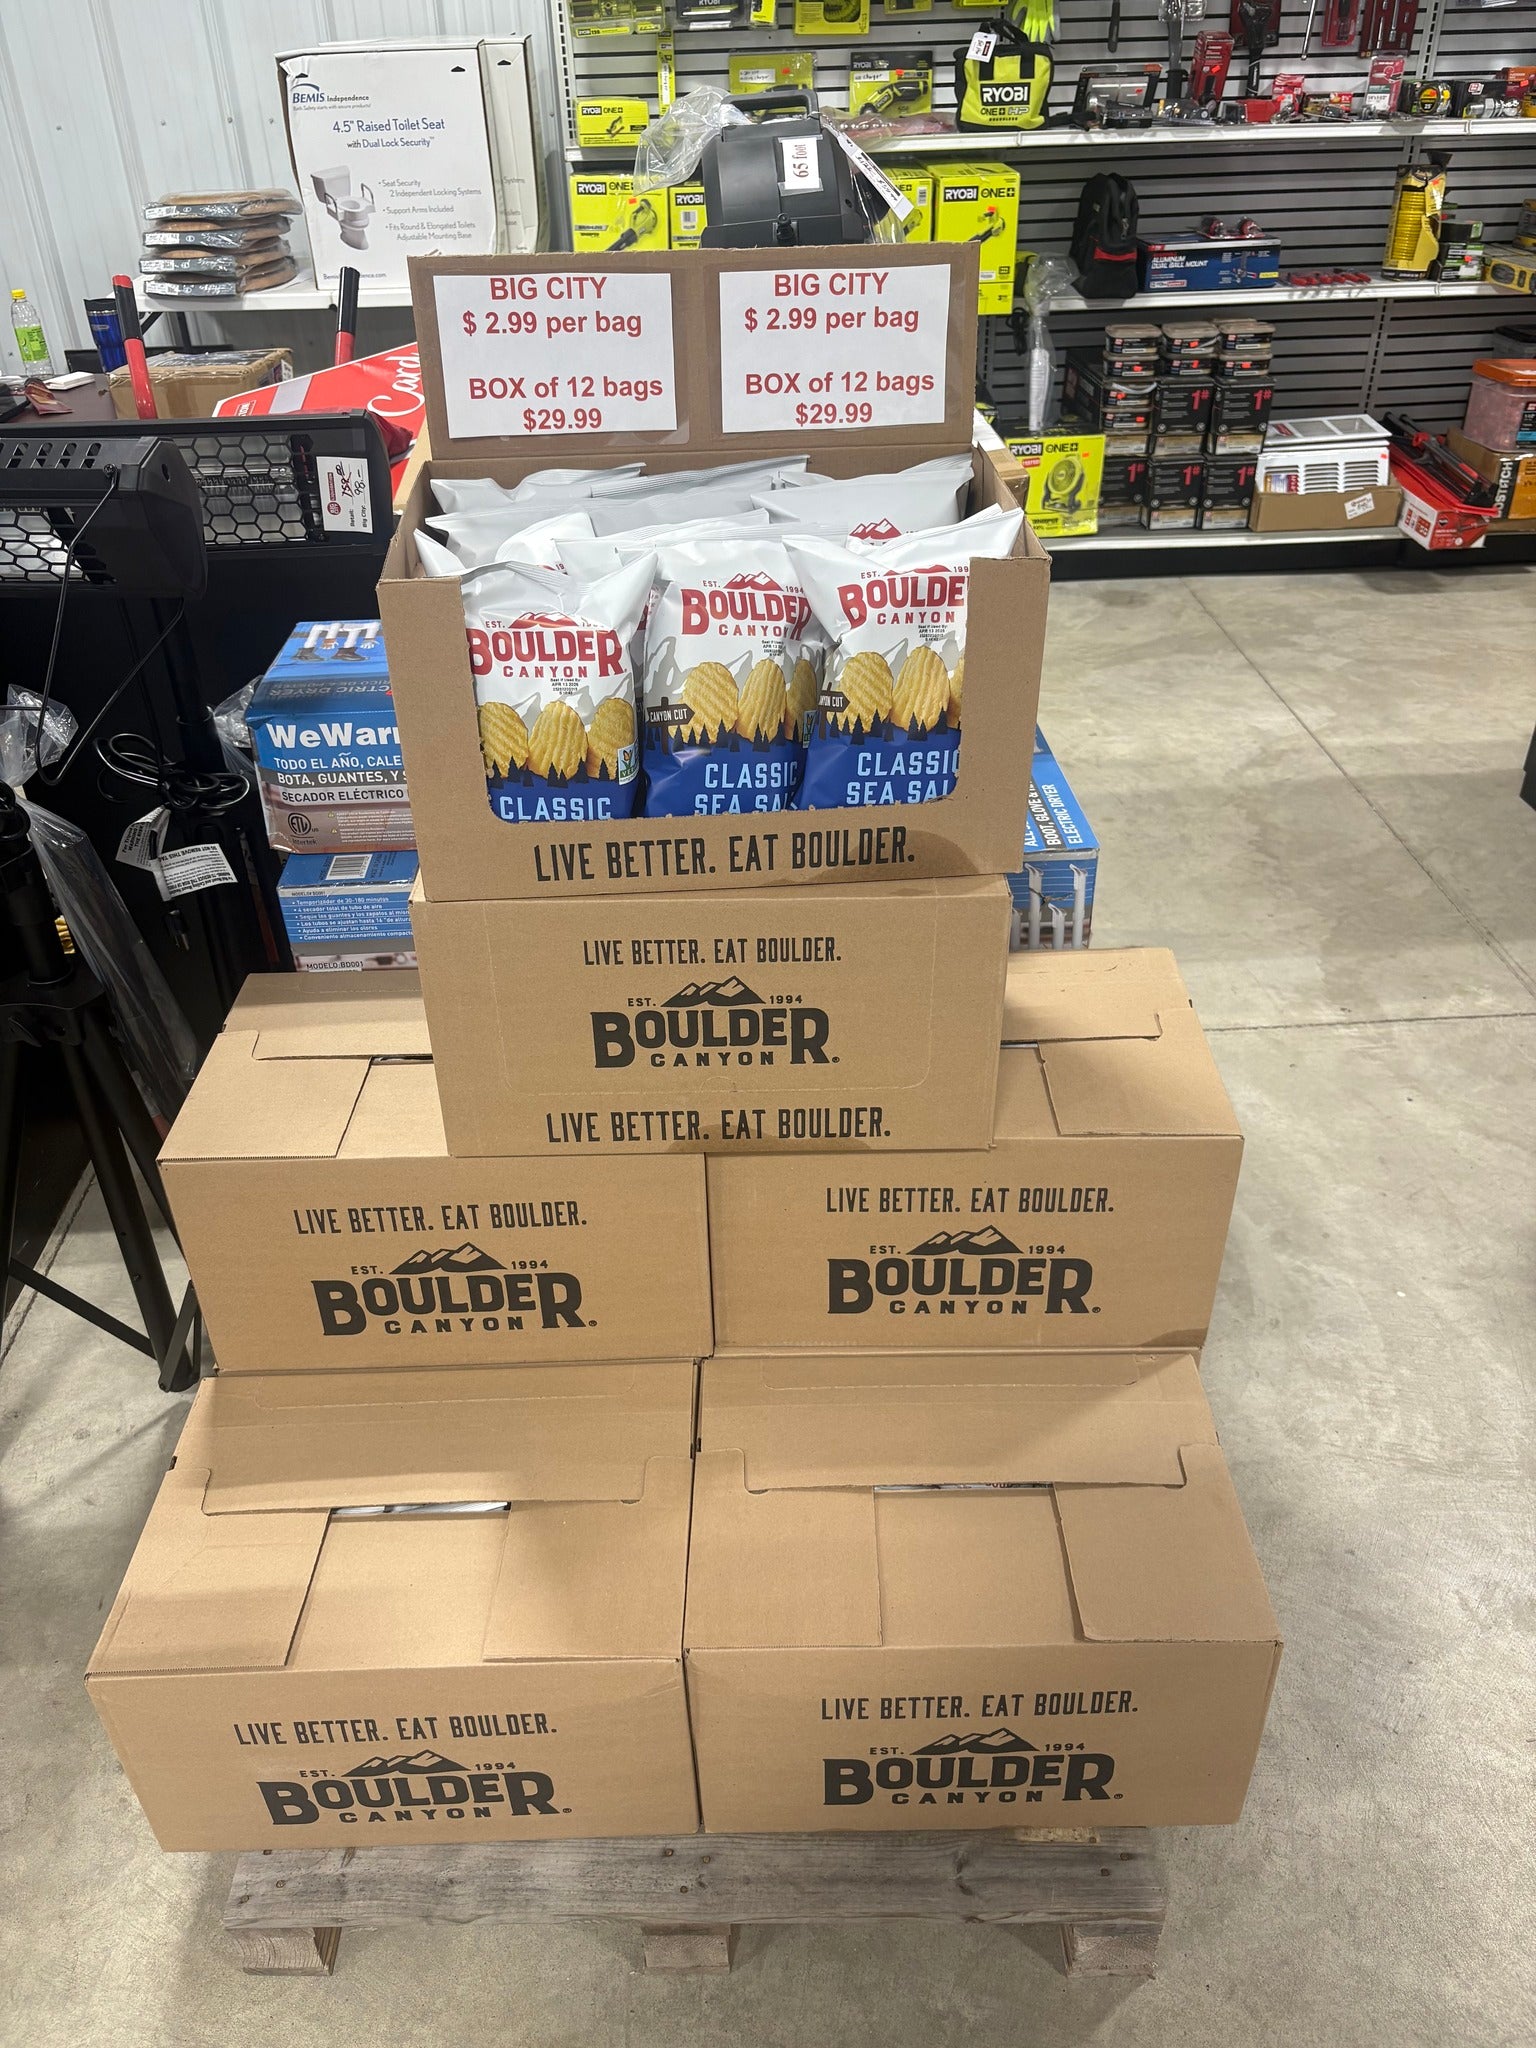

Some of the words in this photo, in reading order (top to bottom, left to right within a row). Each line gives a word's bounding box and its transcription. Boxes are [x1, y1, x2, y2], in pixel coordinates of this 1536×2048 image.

[292, 92, 325, 104] BEMIS
[326, 94, 370, 103] Independence
[982, 87, 1029, 103] RYOBI
[1007, 107, 1030, 116] HP
[333, 120, 355, 133] 4.5"
[357, 119, 391, 132] Raised
[392, 118, 421, 131] Toilet
[422, 117, 445, 130] Seat
[347, 139, 362, 149] with
[362, 138, 380, 148] Dual
[381, 138, 399, 147] Lock
[792, 162, 809, 178] 65
[382, 179, 396, 188] Seat
[396, 178, 421, 188] Security
[578, 183, 606, 195] RYOBI
[395, 188, 432, 198] Independent
[432, 188, 457, 197] Locking
[457, 187, 482, 197] Systems
[676, 194, 704, 206] RYOBI
[945, 188, 977, 200] RYOBI
[386, 207, 410, 216] Support
[411, 206, 428, 214] Arms
[428, 205, 454, 213] Included
[389, 223, 399, 231] Fits
[400, 222, 420, 230] Round
[426, 222, 457, 231] Elongated
[457, 221, 476, 229] Toilets
[396, 232, 427, 241] Adjustable
[427, 231, 457, 240] Mounting
[457, 231, 472, 239] Base
[1185, 260, 1208, 268] MOUNT
[490, 277, 538, 300] BIG
[546, 276, 607, 300] CITY
[774, 273, 820, 297] BIG
[829, 272, 889, 296] CITY
[462, 310, 477, 337] $
[485, 311, 537, 334] 2.99
[546, 315, 587, 338] per
[596, 310, 642, 338] bag
[744, 307, 758, 333] $
[766, 307, 817, 330] 2.99
[826, 311, 866, 334] per
[874, 306, 919, 333] bag
[367, 352, 423, 417] Card
[469, 377, 527, 400] BOX
[534, 376, 559, 398] of
[567, 376, 595, 397] 12
[603, 375, 663, 402] bags
[745, 372, 801, 395] BOX
[808, 372, 834, 393] of
[841, 371, 868, 392] 12
[876, 371, 935, 396] bags
[523, 407, 602, 433] $29.99
[795, 402, 873, 427] $29.99
[1010, 444, 1042, 456] RYOBI
[860, 571, 881, 580] EST.
[703, 580, 721, 588] EST.
[785, 585, 804, 594] 1994
[837, 576, 971, 630] BOULDE
[681, 588, 813, 642] BOULDER
[876, 611, 955, 625] CANYON
[485, 620, 505, 629] EST.
[466, 628, 623, 678] BOULDER
[503, 666, 588, 678] CANYON
[831, 696, 844, 708] CUT
[650, 710, 671, 722] CANYON
[674, 708, 688, 721] CUT
[273, 757, 307, 771] TODO
[311, 757, 328, 769] EL
[331, 751, 364, 769] AÑO,
[277, 772, 315, 786] BOTA,
[318, 771, 388, 784] GUANTES,
[390, 770, 398, 782] Y
[704, 761, 798, 789] CLASSIC
[282, 791, 335, 803] SECADOR
[338, 788, 404, 801] ELÉCTRICO
[846, 781, 895, 805] SEA
[1041, 783, 1062, 809] DRYER
[499, 796, 611, 821] CLASSIC
[694, 794, 742, 816] SEA
[1028, 800, 1050, 823] GLOVE
[1038, 821, 1062, 847] BOOT,
[1052, 807, 1084, 845] ELECTRIC
[533, 843, 595, 882] LIVE
[606, 837, 716, 879] BETTER.
[729, 834, 779, 873] EAT
[791, 826, 915, 869] BOULDER.
[583, 939, 624, 966] LIVE
[631, 938, 706, 965] BETTER.
[713, 938, 748, 964] EAT
[756, 936, 842, 963] BOULDER.
[627, 997, 657, 1007] EST.
[769, 994, 803, 1004] 1994
[590, 1007, 831, 1069] BOULDER
[650, 1051, 774, 1068] CANYON
[546, 1112, 601, 1143] LIVE
[610, 1110, 710, 1142] BETTER.
[721, 1109, 767, 1140] EAT
[778, 1106, 891, 1139] BOULDER.
[826, 1187, 870, 1213] LIVE
[879, 1187, 961, 1213] BETTER.
[970, 1187, 1010, 1213] EAT
[1018, 1187, 1115, 1213] BOULDER.
[293, 1208, 342, 1235] LIVE
[347, 1205, 434, 1234] BETTER.
[441, 1204, 480, 1231] EAT
[489, 1200, 588, 1230] BOULDER.
[869, 1245, 902, 1255] EST.
[1028, 1245, 1066, 1255] 1994
[351, 1264, 384, 1276] EST.
[511, 1259, 549, 1271] 1994
[826, 1257, 1094, 1315] BOULDER
[310, 1272, 587, 1337] BOULDER
[889, 1299, 1028, 1315] CANYON
[384, 1316, 524, 1335] CANYON
[820, 1697, 870, 1721] LIVE
[879, 1695, 971, 1720] BETTER.
[981, 1694, 1025, 1718] EAT
[1033, 1690, 1139, 1717] BOULDER.
[233, 1722, 292, 1746] LIVE
[293, 1718, 389, 1744] BETTER.
[396, 1716, 439, 1741] EAT
[449, 1712, 558, 1739] BOULDER.
[869, 1746, 905, 1756] EST.
[1044, 1742, 1086, 1752] 1994
[299, 1769, 336, 1778] EST.
[475, 1761, 517, 1772] 1994
[823, 1752, 1116, 1806] BOULDER
[256, 1770, 561, 1826] BOULDER
[891, 1790, 1044, 1806] CANYON
[339, 1806, 493, 1824] CANYON
